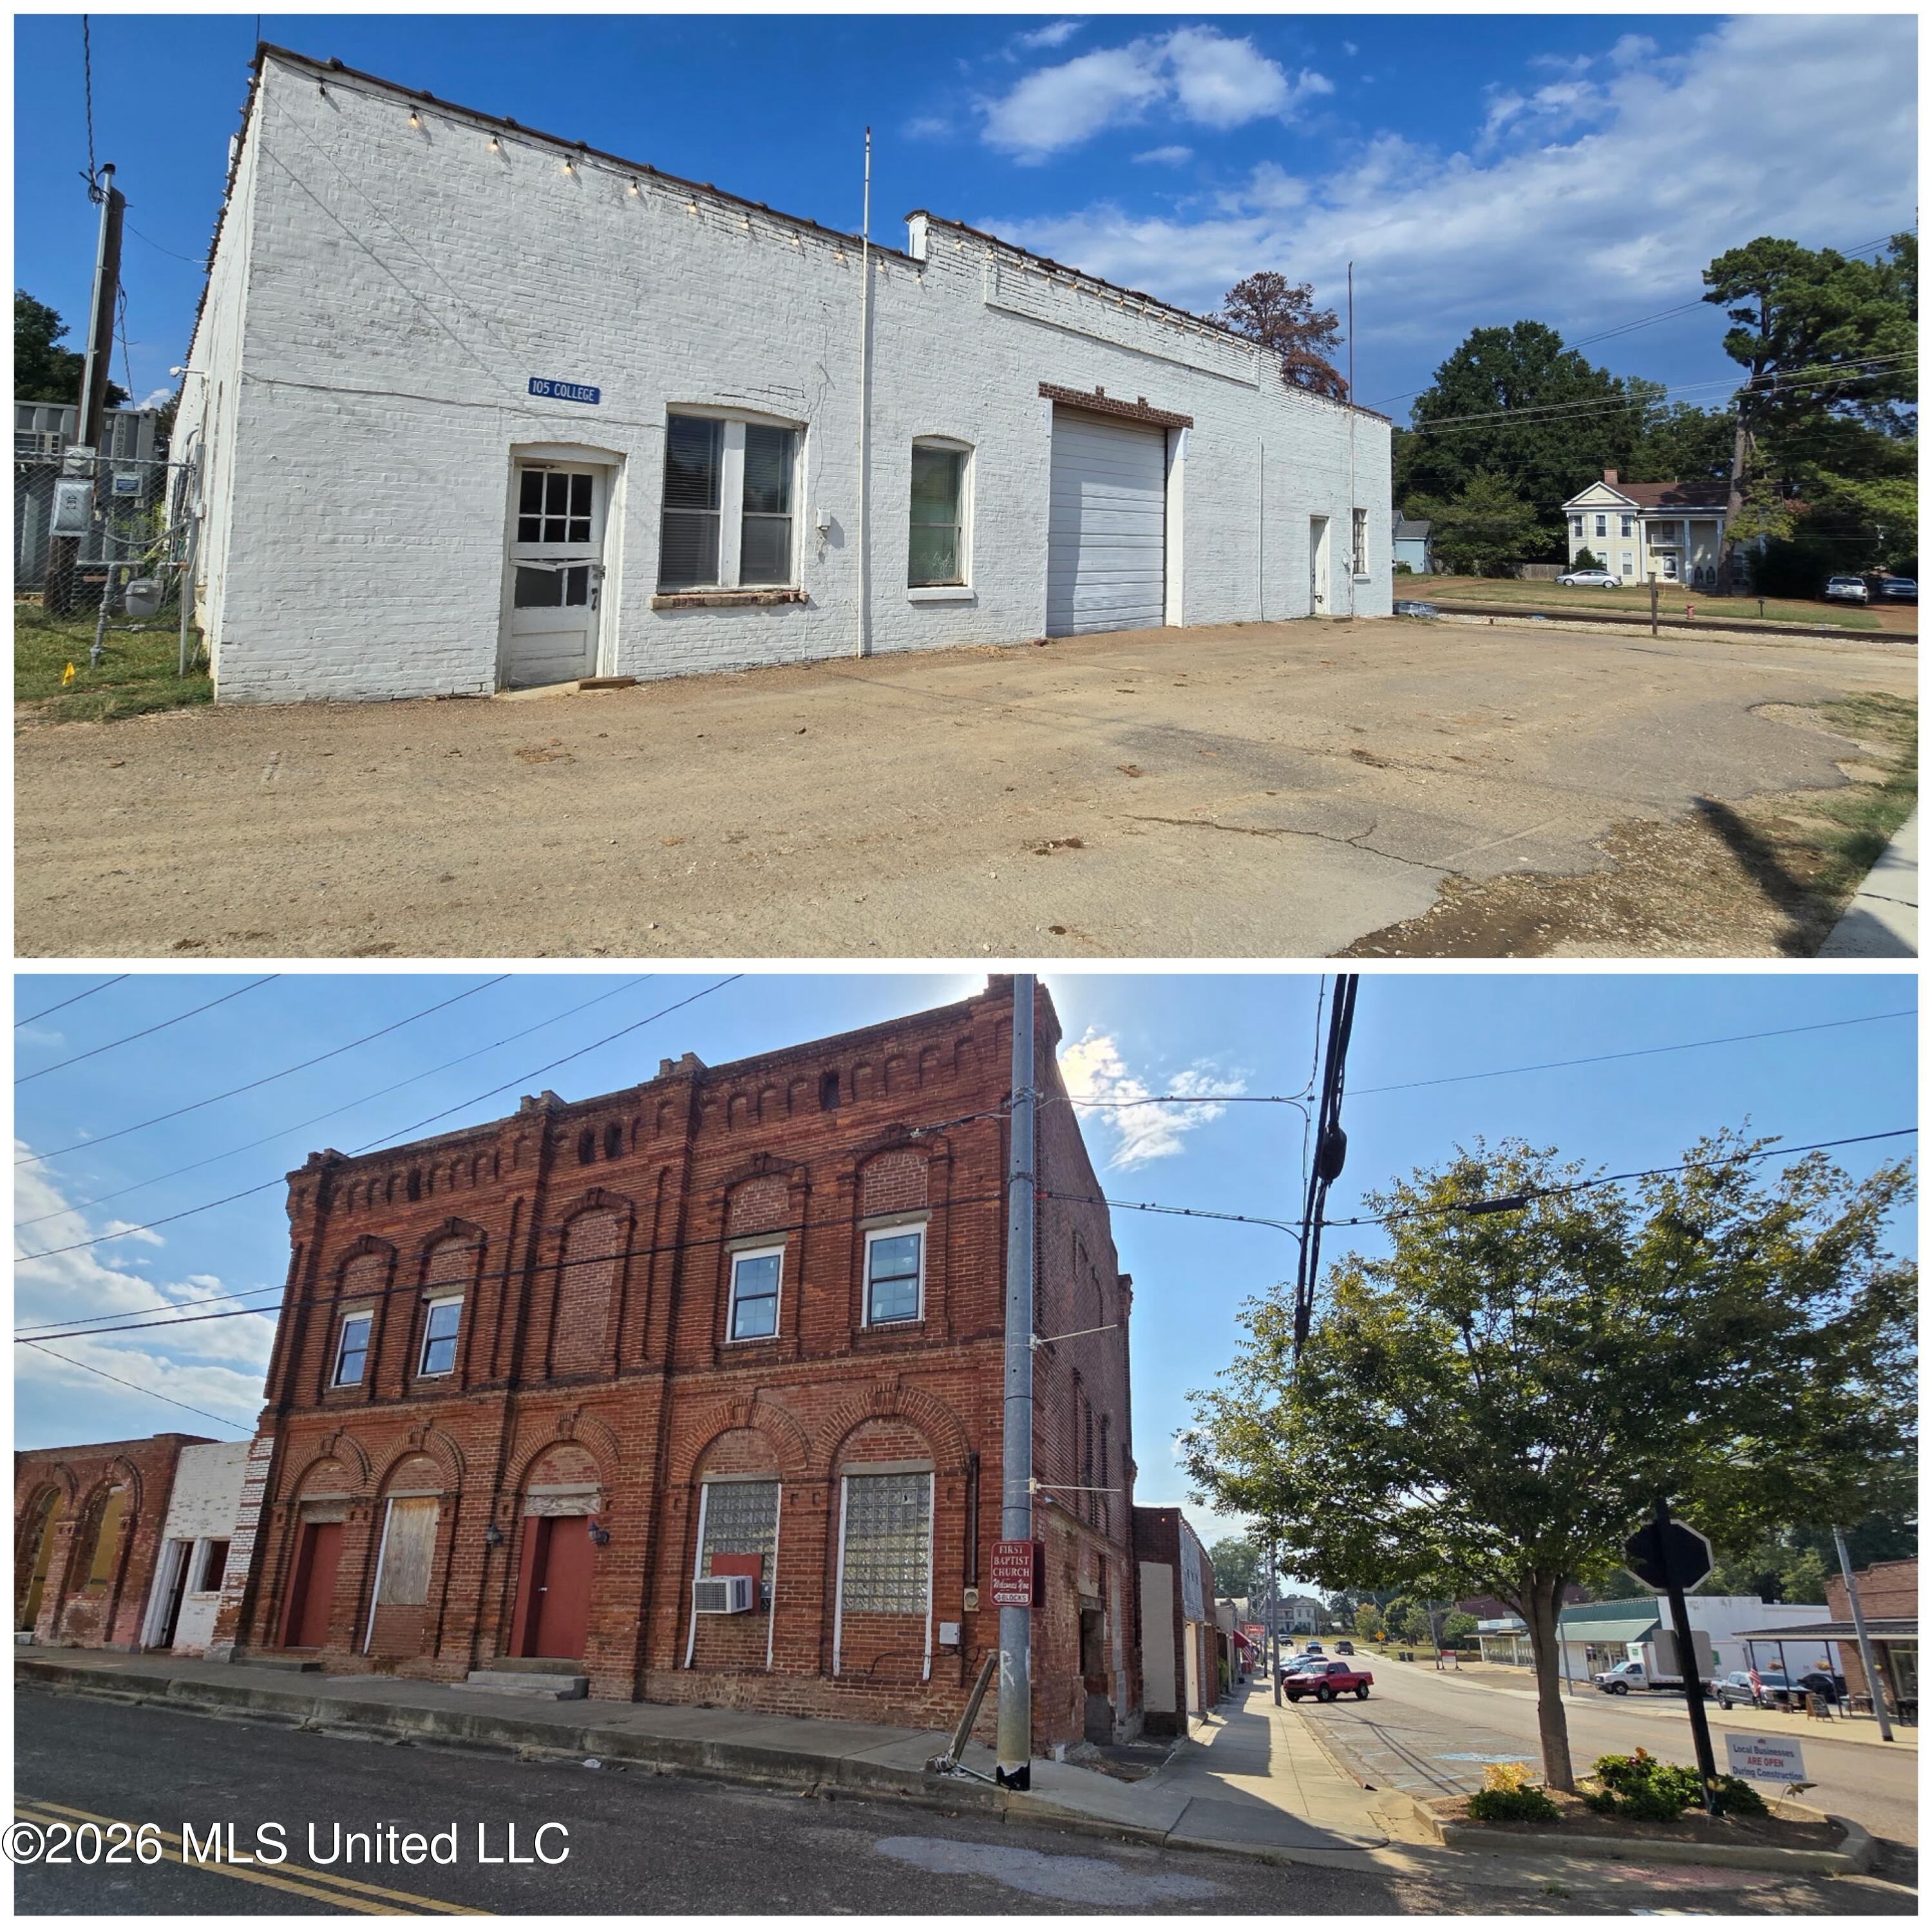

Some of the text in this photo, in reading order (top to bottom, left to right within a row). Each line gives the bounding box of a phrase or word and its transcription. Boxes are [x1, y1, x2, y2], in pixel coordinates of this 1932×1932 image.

[533, 380, 594, 401] 105 COLLEGE
[999, 1546, 1023, 1554] FIRST
[994, 1556, 1029, 1565] BAPTIST
[993, 1568, 1029, 1577] CHURCH
[1733, 1744, 1794, 1757] Local Businesses
[1747, 1756, 1784, 1768] ARE OPEN
[1732, 1766, 1803, 1781] During Construction
